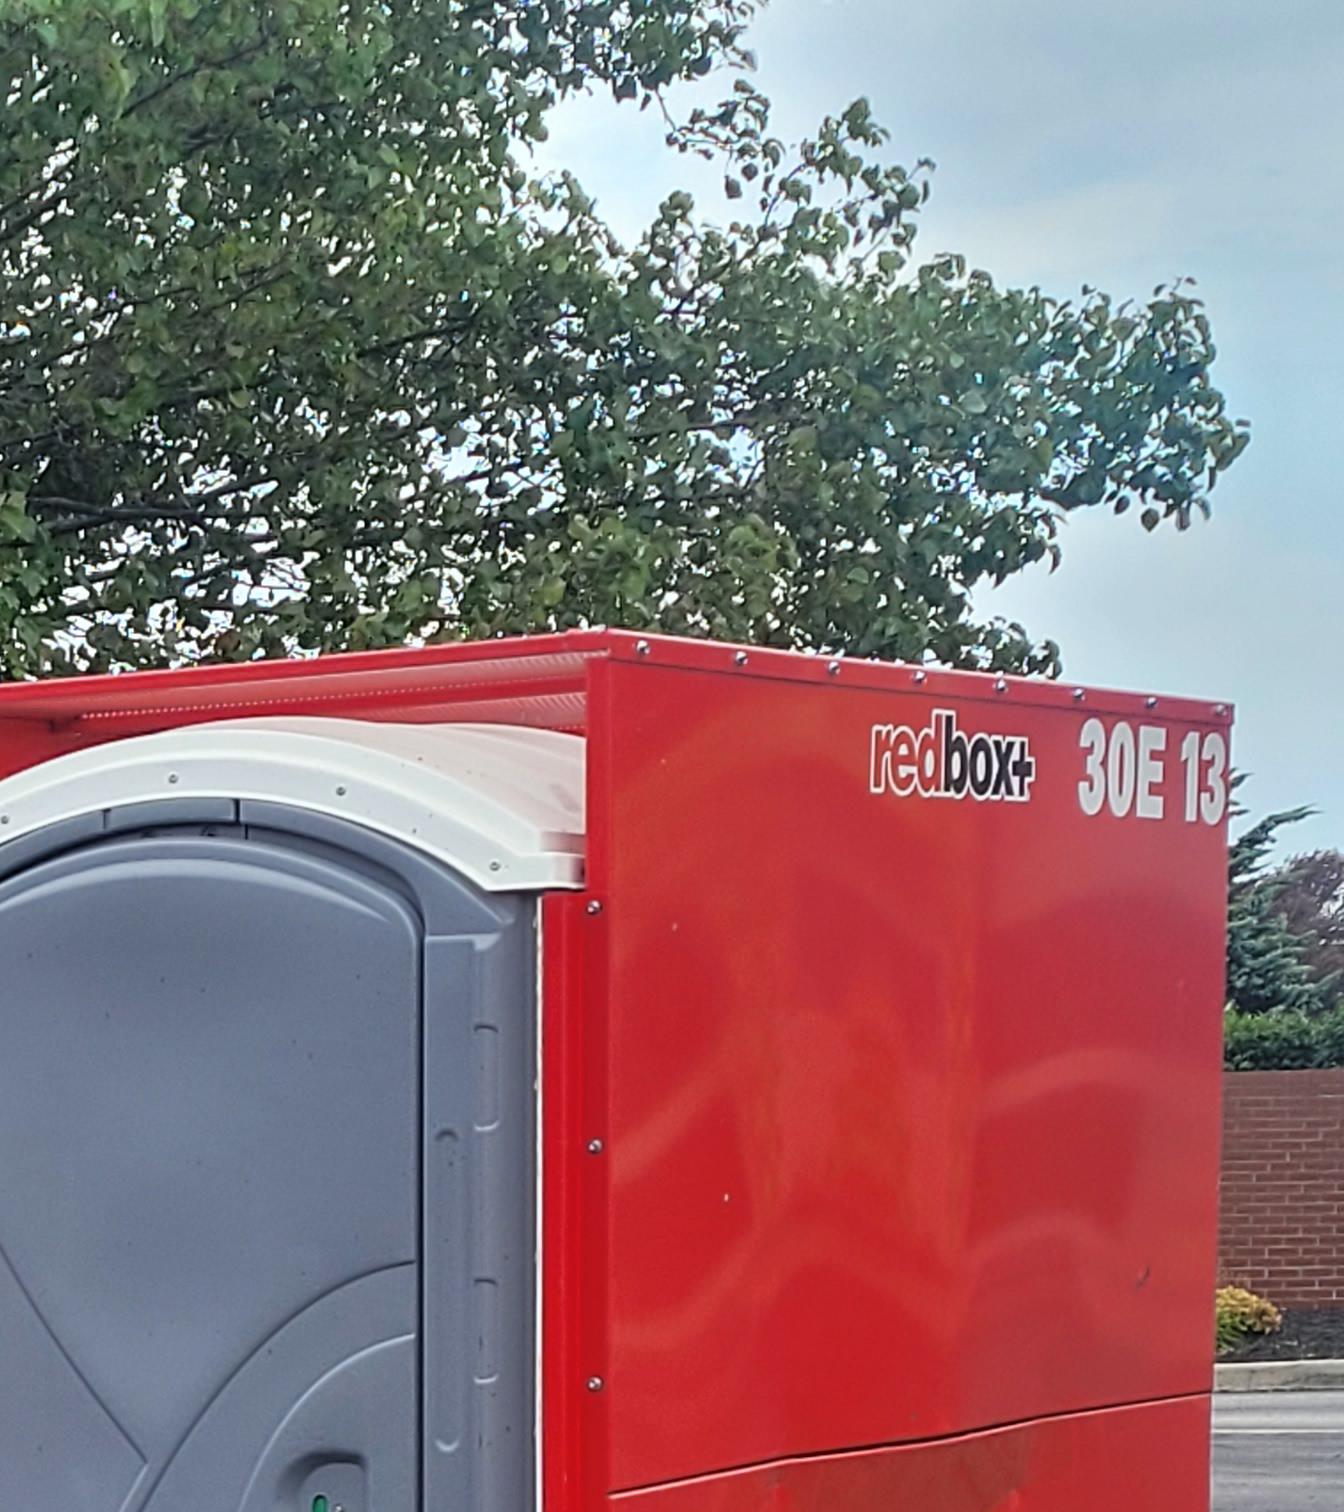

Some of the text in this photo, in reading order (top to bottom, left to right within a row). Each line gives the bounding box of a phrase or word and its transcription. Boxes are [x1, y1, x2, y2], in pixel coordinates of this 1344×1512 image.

[870, 708, 1036, 802] redbox+
[1077, 717, 1227, 826] 30E 13
